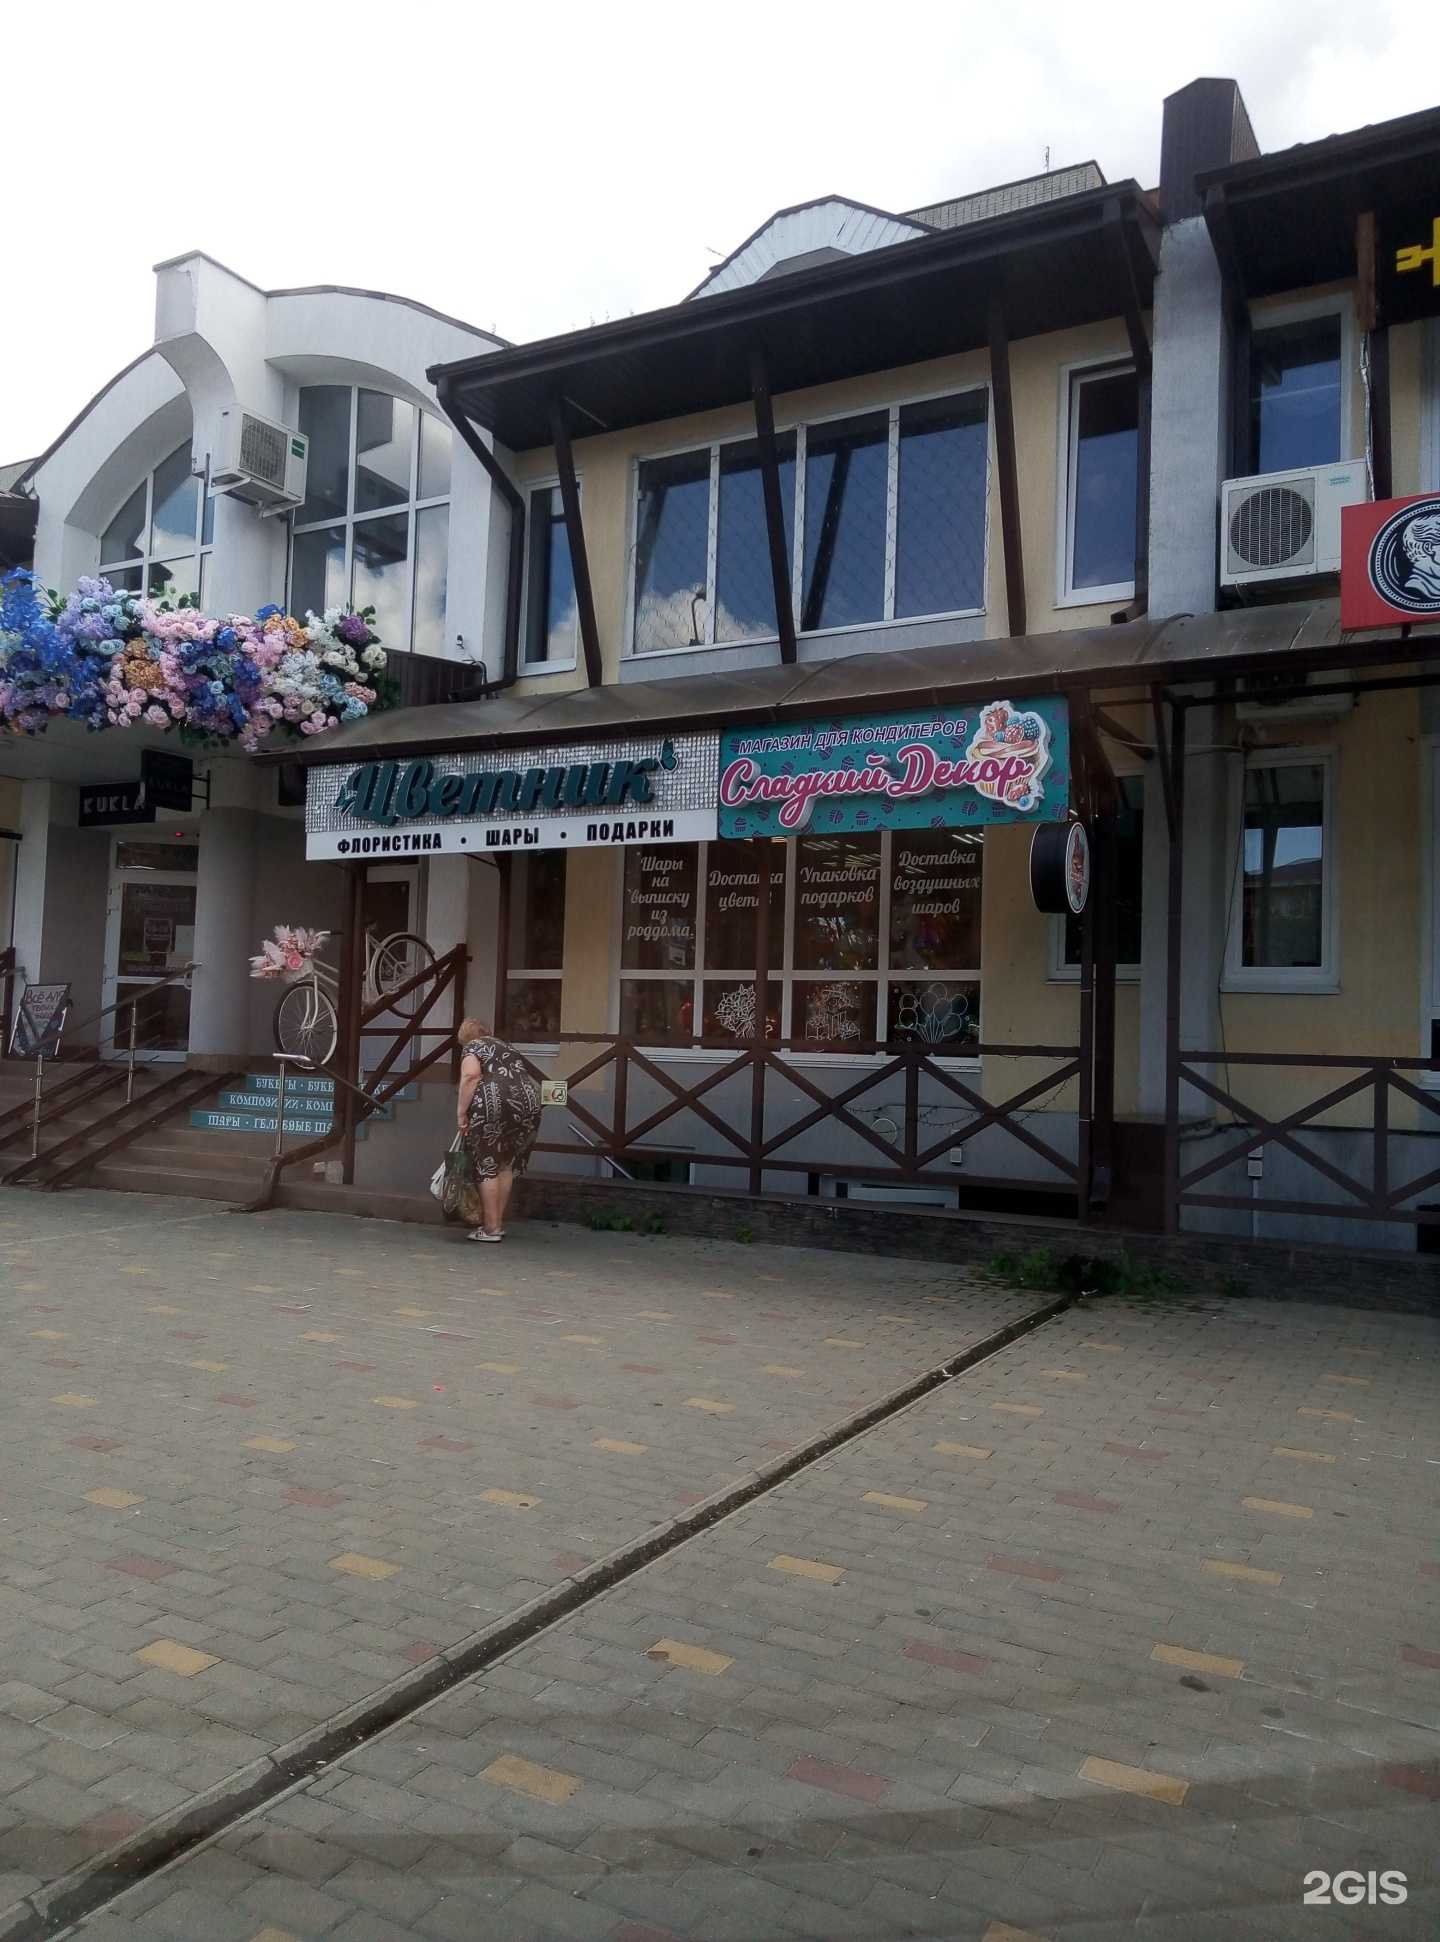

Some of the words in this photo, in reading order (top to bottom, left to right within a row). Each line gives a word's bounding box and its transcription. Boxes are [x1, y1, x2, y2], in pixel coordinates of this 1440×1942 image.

[738, 733, 812, 755] МАГАЗИН
[814, 730, 849, 751] ДЛЯ
[851, 719, 968, 744] КОНДИТЕРОВ
[343, 757, 660, 827] Цветник
[720, 754, 889, 828] Сладкий
[887, 743, 1034, 800] Декор
[83, 795, 146, 814] KUKLA
[337, 832, 442, 855] ФЛОРИСТИКА
[486, 827, 539, 847] ШАРЫ
[586, 819, 675, 842] ПОДАРКИ
[640, 856, 684, 875] Шары
[899, 849, 976, 868] Доставка
[651, 876, 670, 888] на
[708, 870, 785, 886] Достака
[800, 865, 877, 884] Упаковка
[894, 875, 981, 896] воздушных
[630, 888, 690, 908] выписку
[800, 884, 874, 908] подарков
[911, 898, 960, 915] шаров
[650, 909, 668, 924] из
[228, 1094, 299, 1110] КОМПОЗИИИ
[207, 1114, 241, 1128] ШАРЫ
